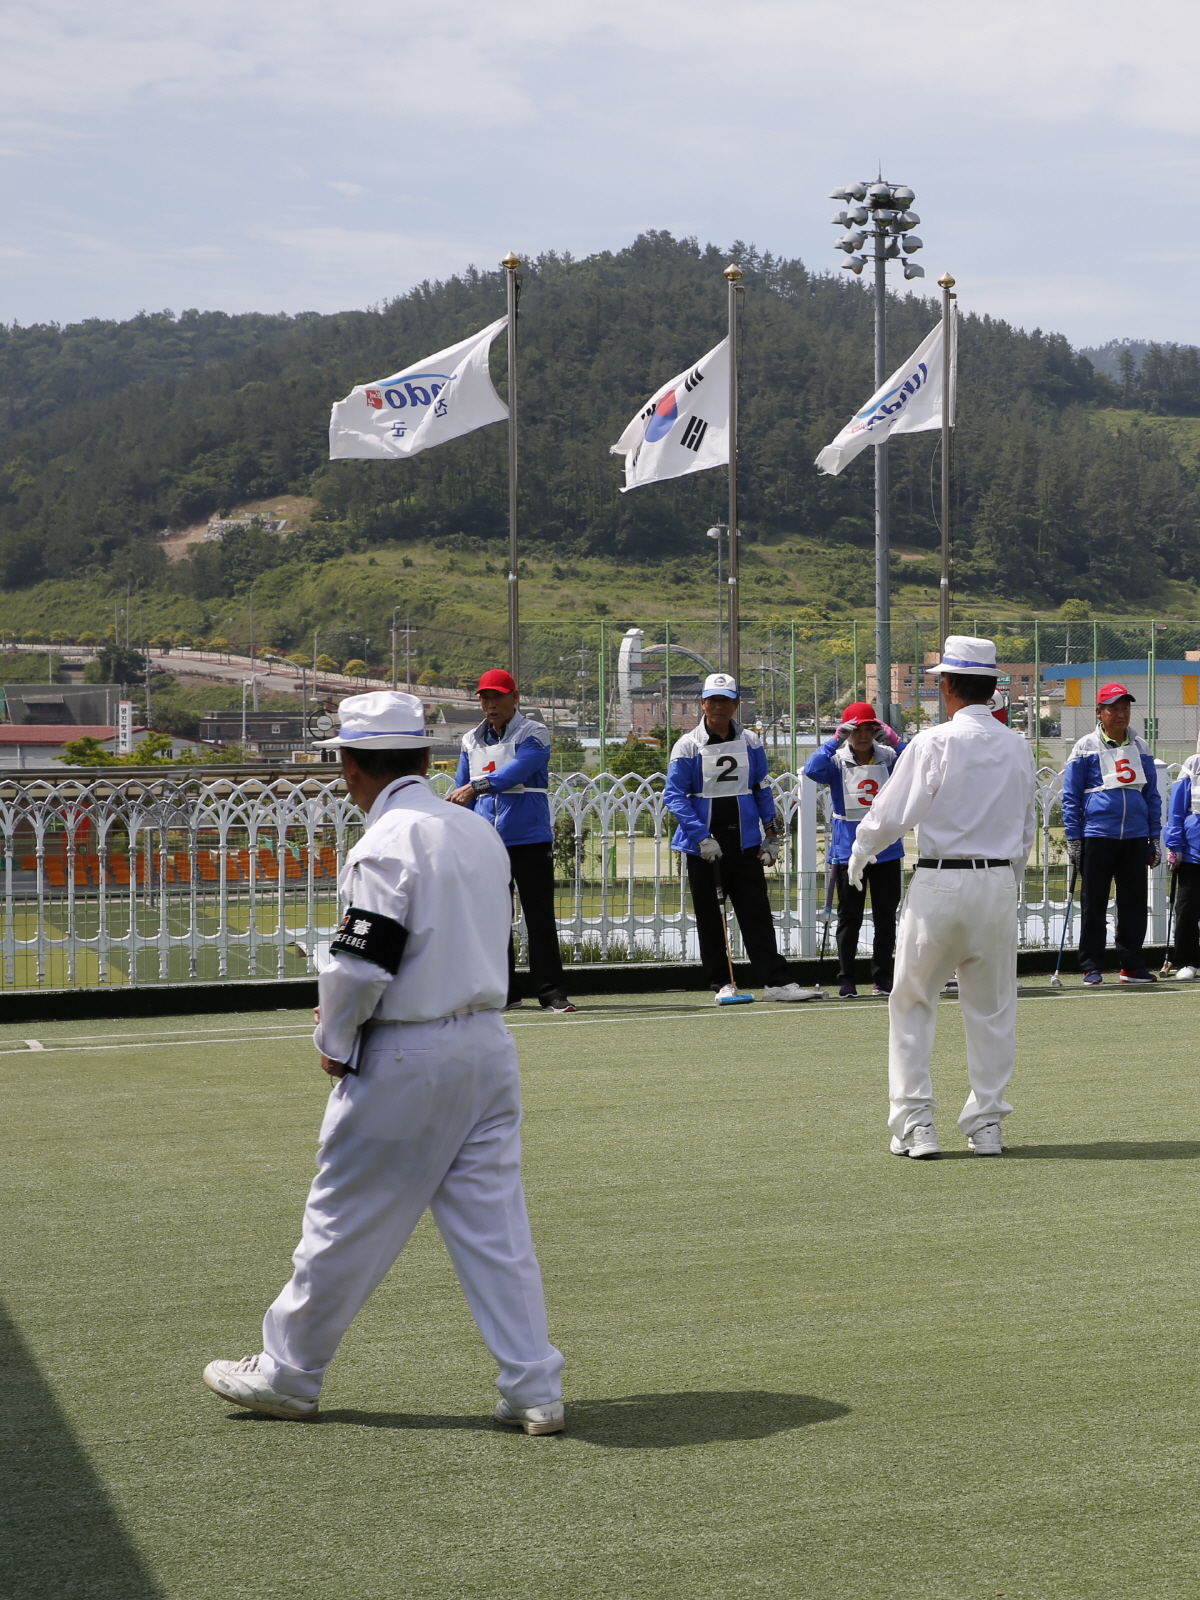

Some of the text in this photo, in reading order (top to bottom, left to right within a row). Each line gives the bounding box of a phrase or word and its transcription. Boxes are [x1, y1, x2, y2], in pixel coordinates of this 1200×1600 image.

[715, 755, 739, 783] 2
[1115, 758, 1137, 784] 5
[857, 779, 879, 806] 3
